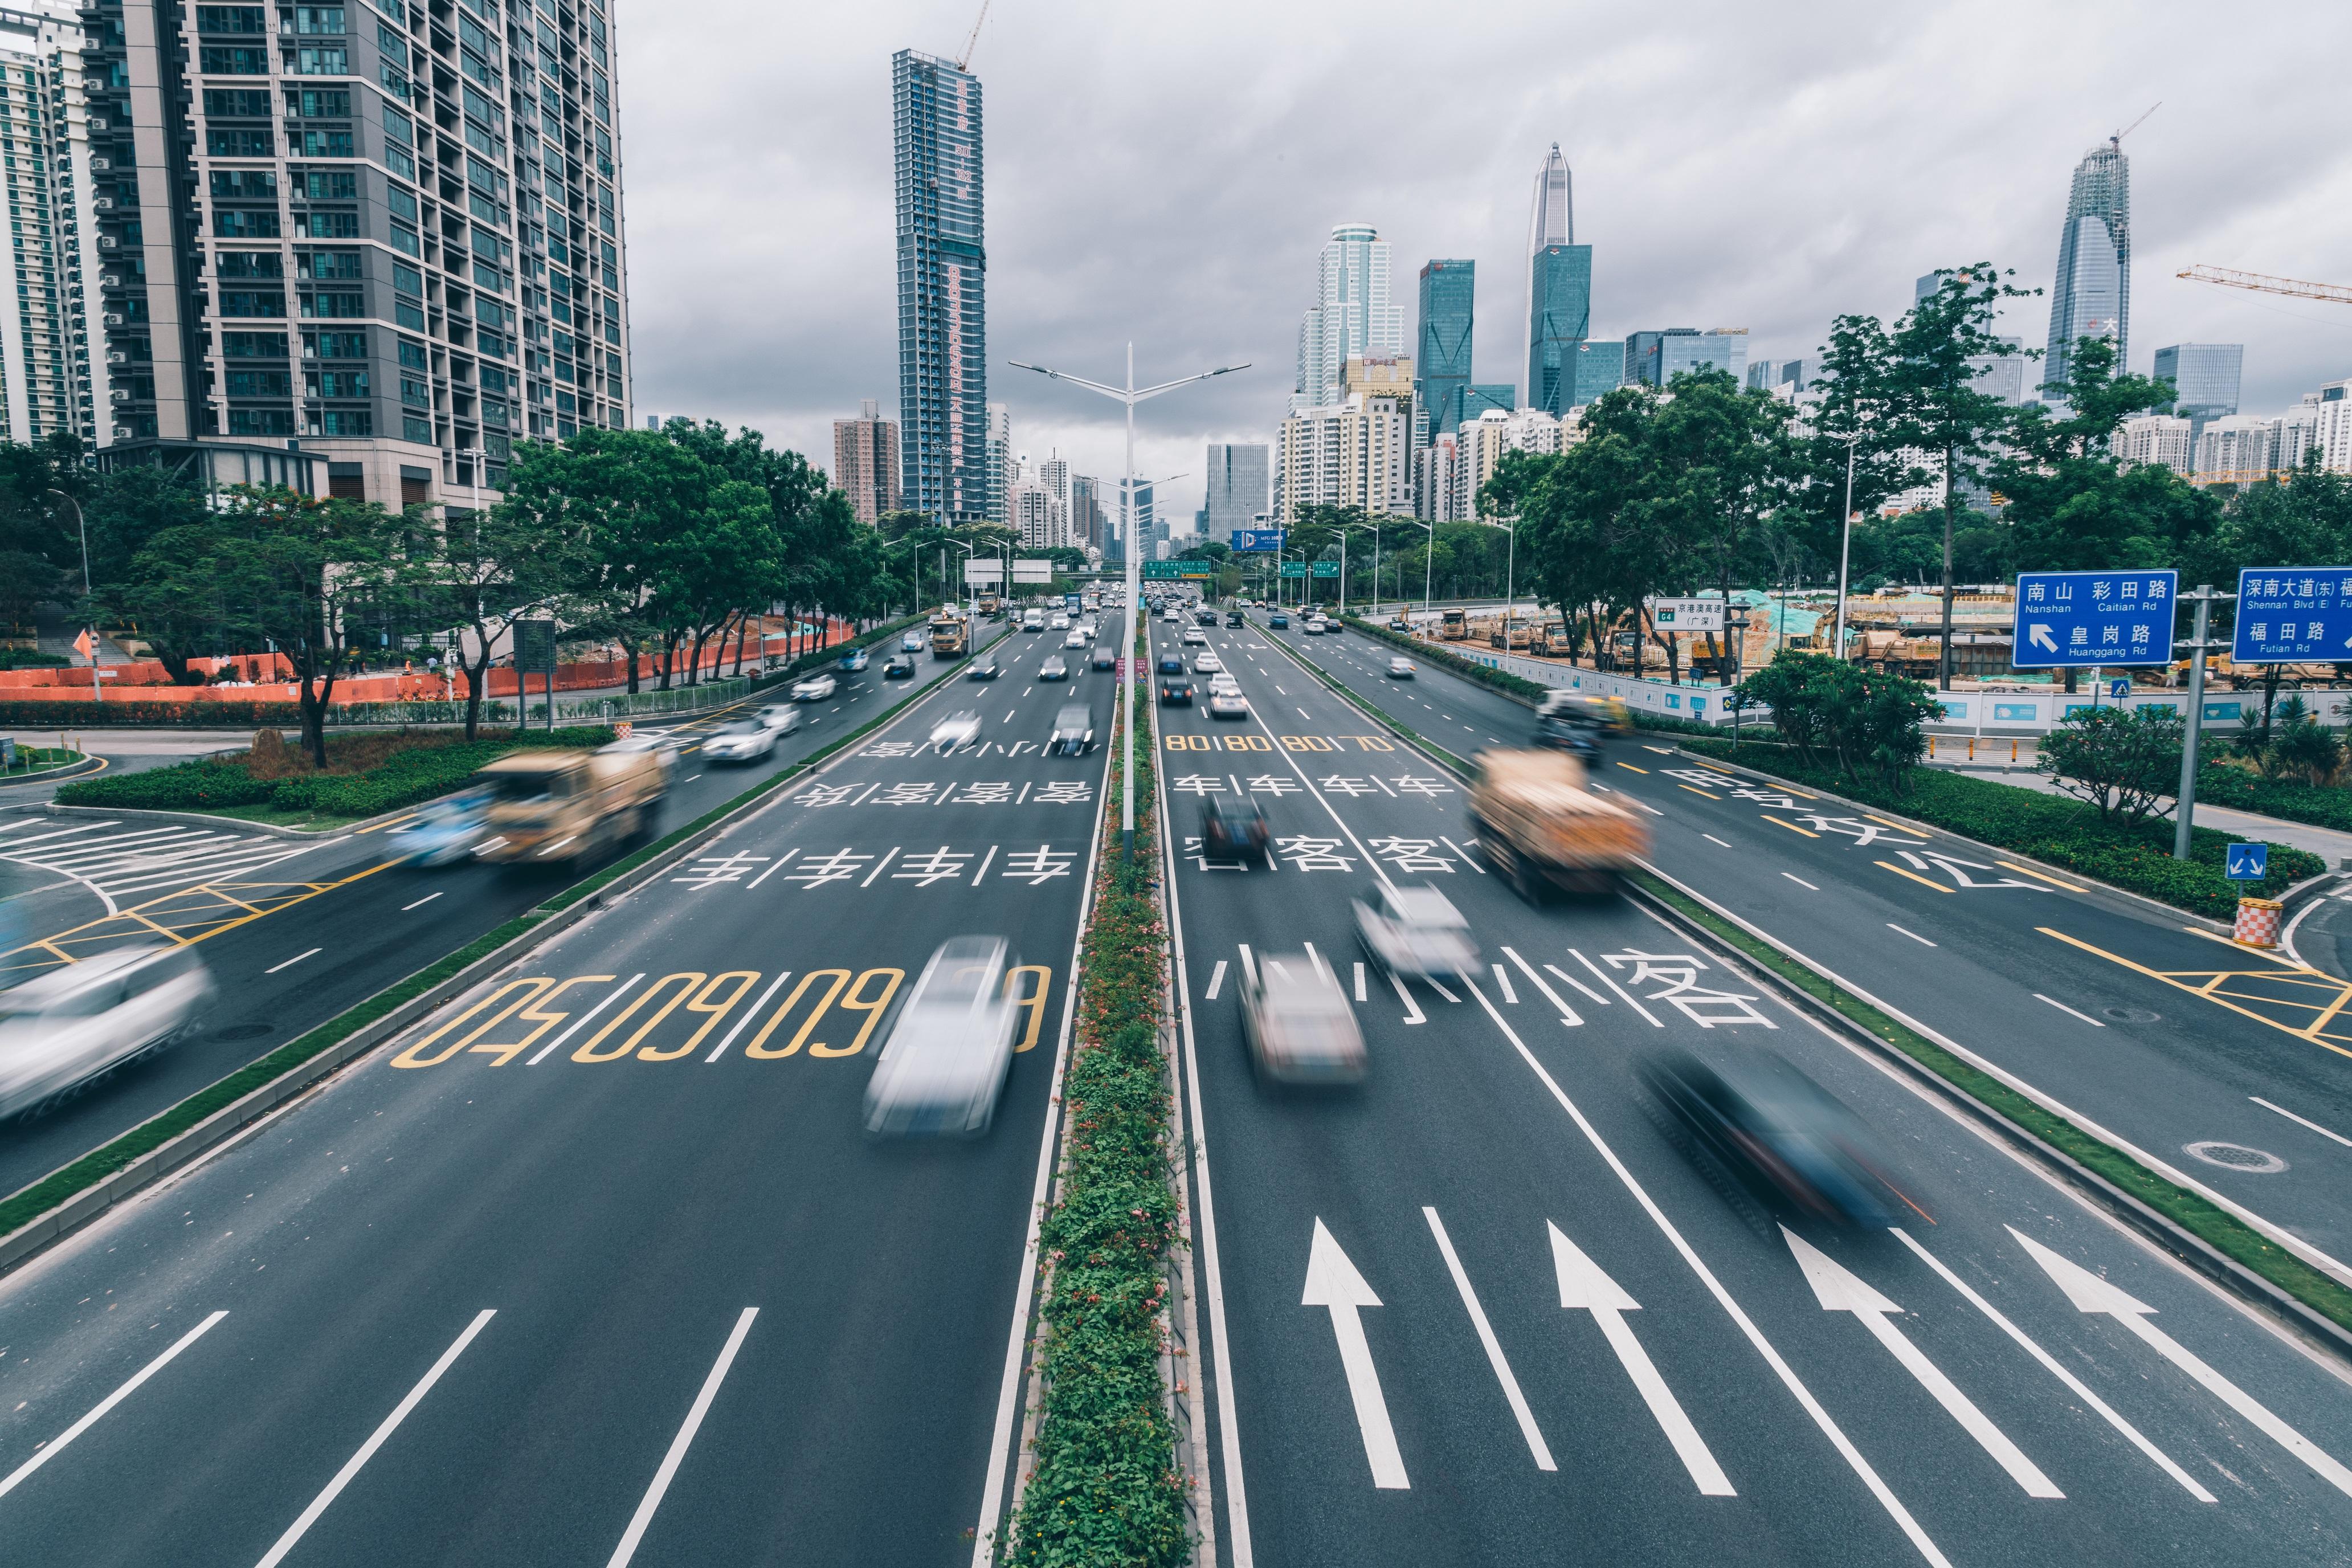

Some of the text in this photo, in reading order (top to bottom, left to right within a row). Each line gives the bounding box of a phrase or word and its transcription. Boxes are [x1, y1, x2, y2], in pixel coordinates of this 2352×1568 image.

[2028, 579, 2167, 602] 南山 彩田路
[1678, 603, 1722, 613] 京港澳高速
[2025, 602, 2157, 613] Nanshan Caitian Rd
[2247, 601, 2287, 609] Shennan
[2294, 600, 2314, 609] Blvd
[2318, 599, 2329, 609] (E)
[1687, 616, 1713, 626] (广深)
[2069, 624, 2150, 644] 皇岗路
[2249, 621, 2325, 641] 福田路
[2069, 647, 2146, 658] Huanggang Rd
[2260, 644, 2310, 652] Futian Rd
[1165, 735, 1395, 752] 80 80 80 70
